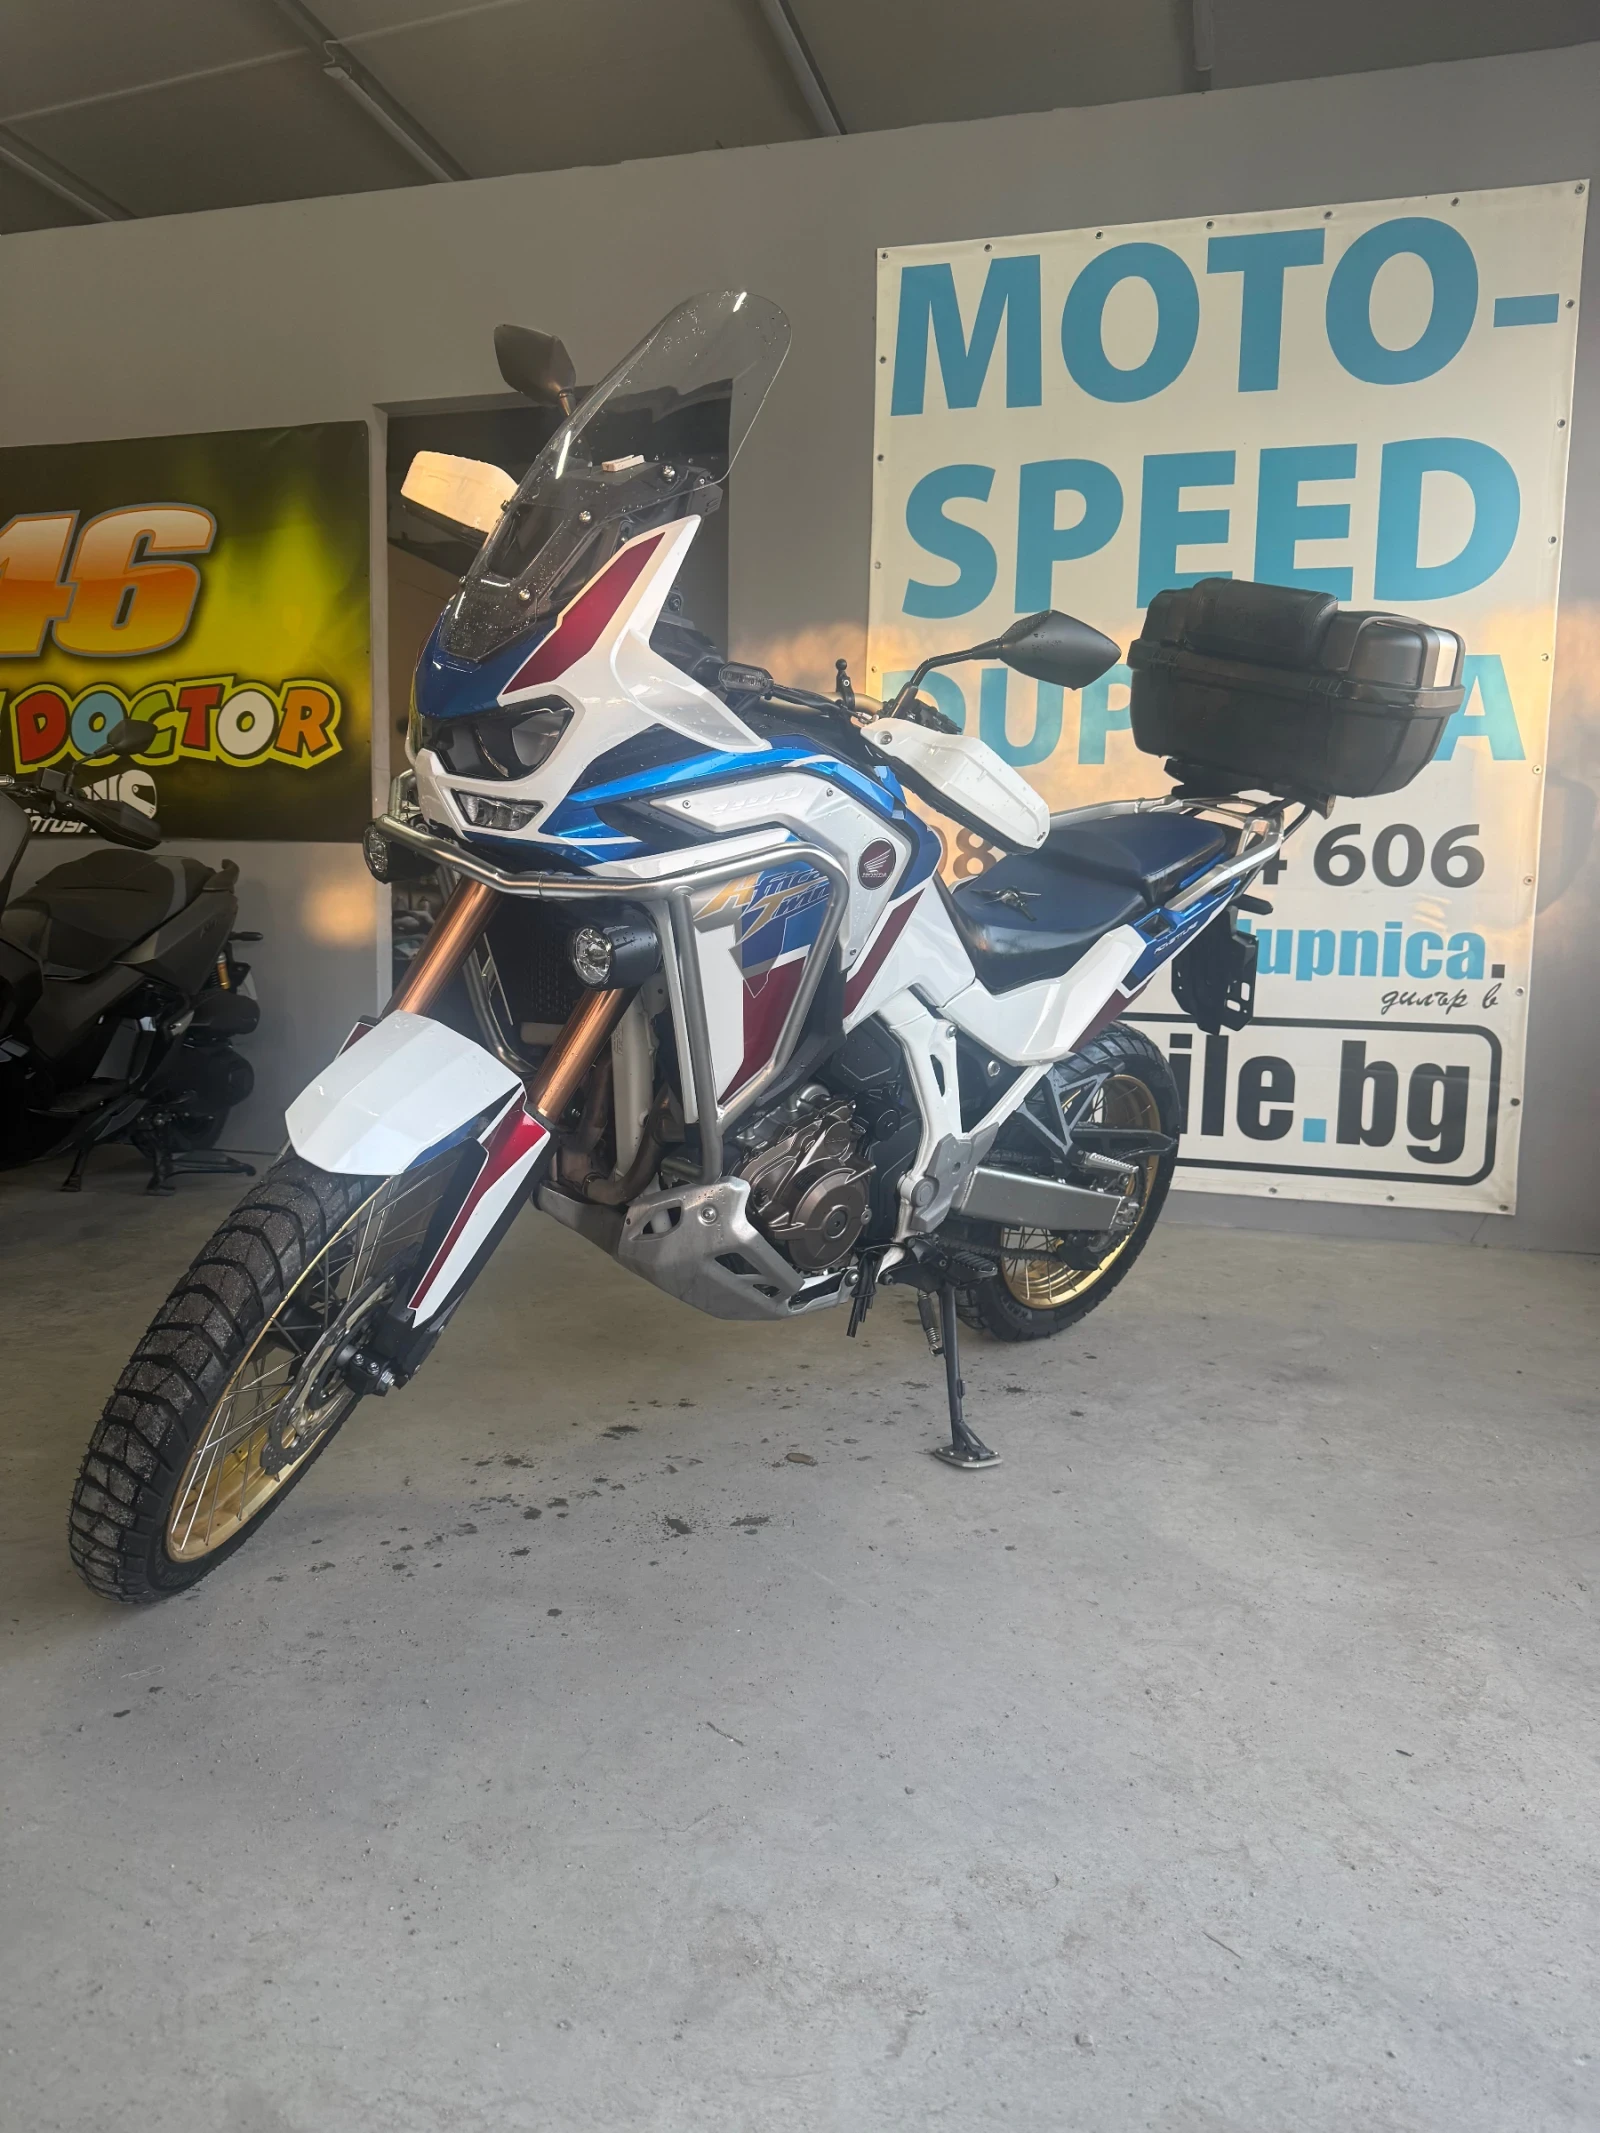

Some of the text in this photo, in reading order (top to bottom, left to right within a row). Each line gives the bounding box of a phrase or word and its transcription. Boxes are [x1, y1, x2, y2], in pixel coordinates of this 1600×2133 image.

[890, 217, 1560, 416] MOTO-
[0, 502, 217, 657] 46
[901, 437, 1521, 619] SPEED
[10, 675, 342, 774] DOCTOR
[1313, 823, 1485, 888] 606
[1236, 919, 1505, 981] upnica.
[1169, 1033, 1470, 1164] ile.bg
